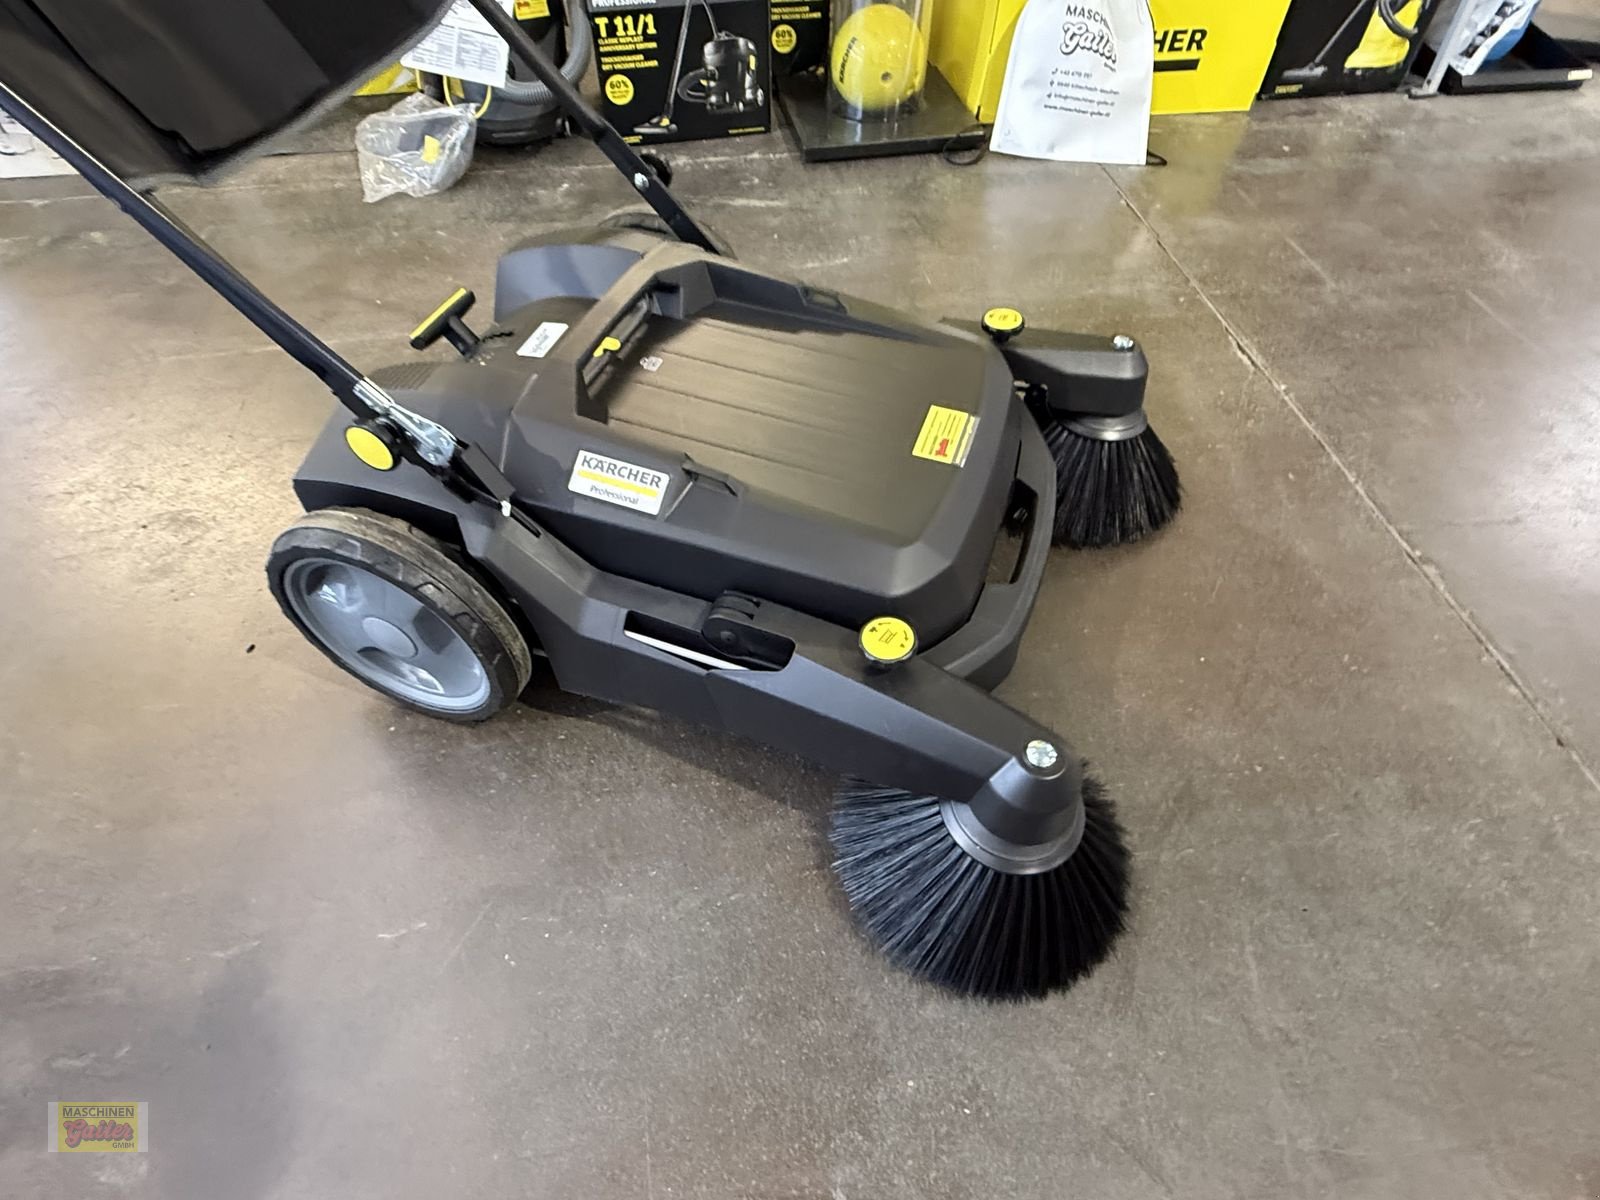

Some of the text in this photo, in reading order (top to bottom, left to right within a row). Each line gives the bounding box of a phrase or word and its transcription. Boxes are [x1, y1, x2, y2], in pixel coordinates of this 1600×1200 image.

[595, 13, 657, 38] T 11/1
[590, 484, 640, 505] Professional
